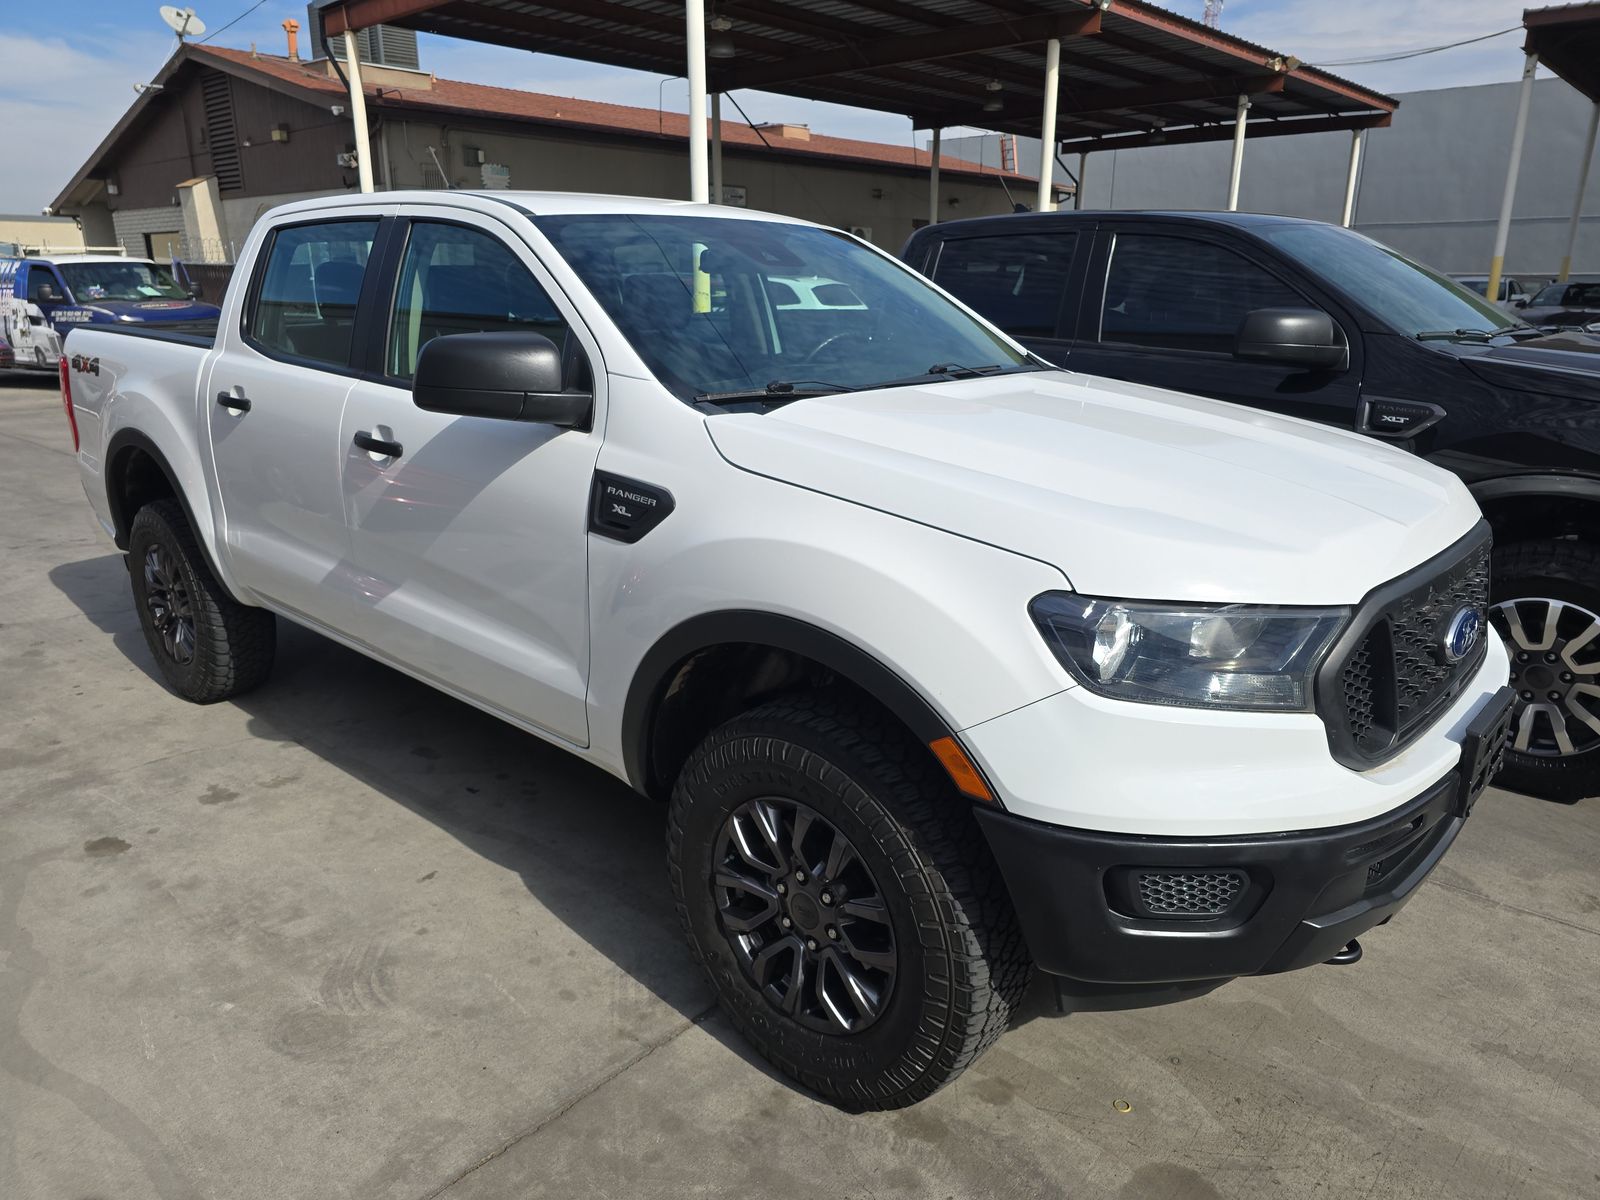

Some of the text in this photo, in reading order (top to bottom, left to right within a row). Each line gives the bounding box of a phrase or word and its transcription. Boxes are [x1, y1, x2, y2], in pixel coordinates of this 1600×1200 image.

[1381, 415, 1410, 424] XLT
[607, 486, 657, 507] RANGER
[611, 503, 632, 517] XL
